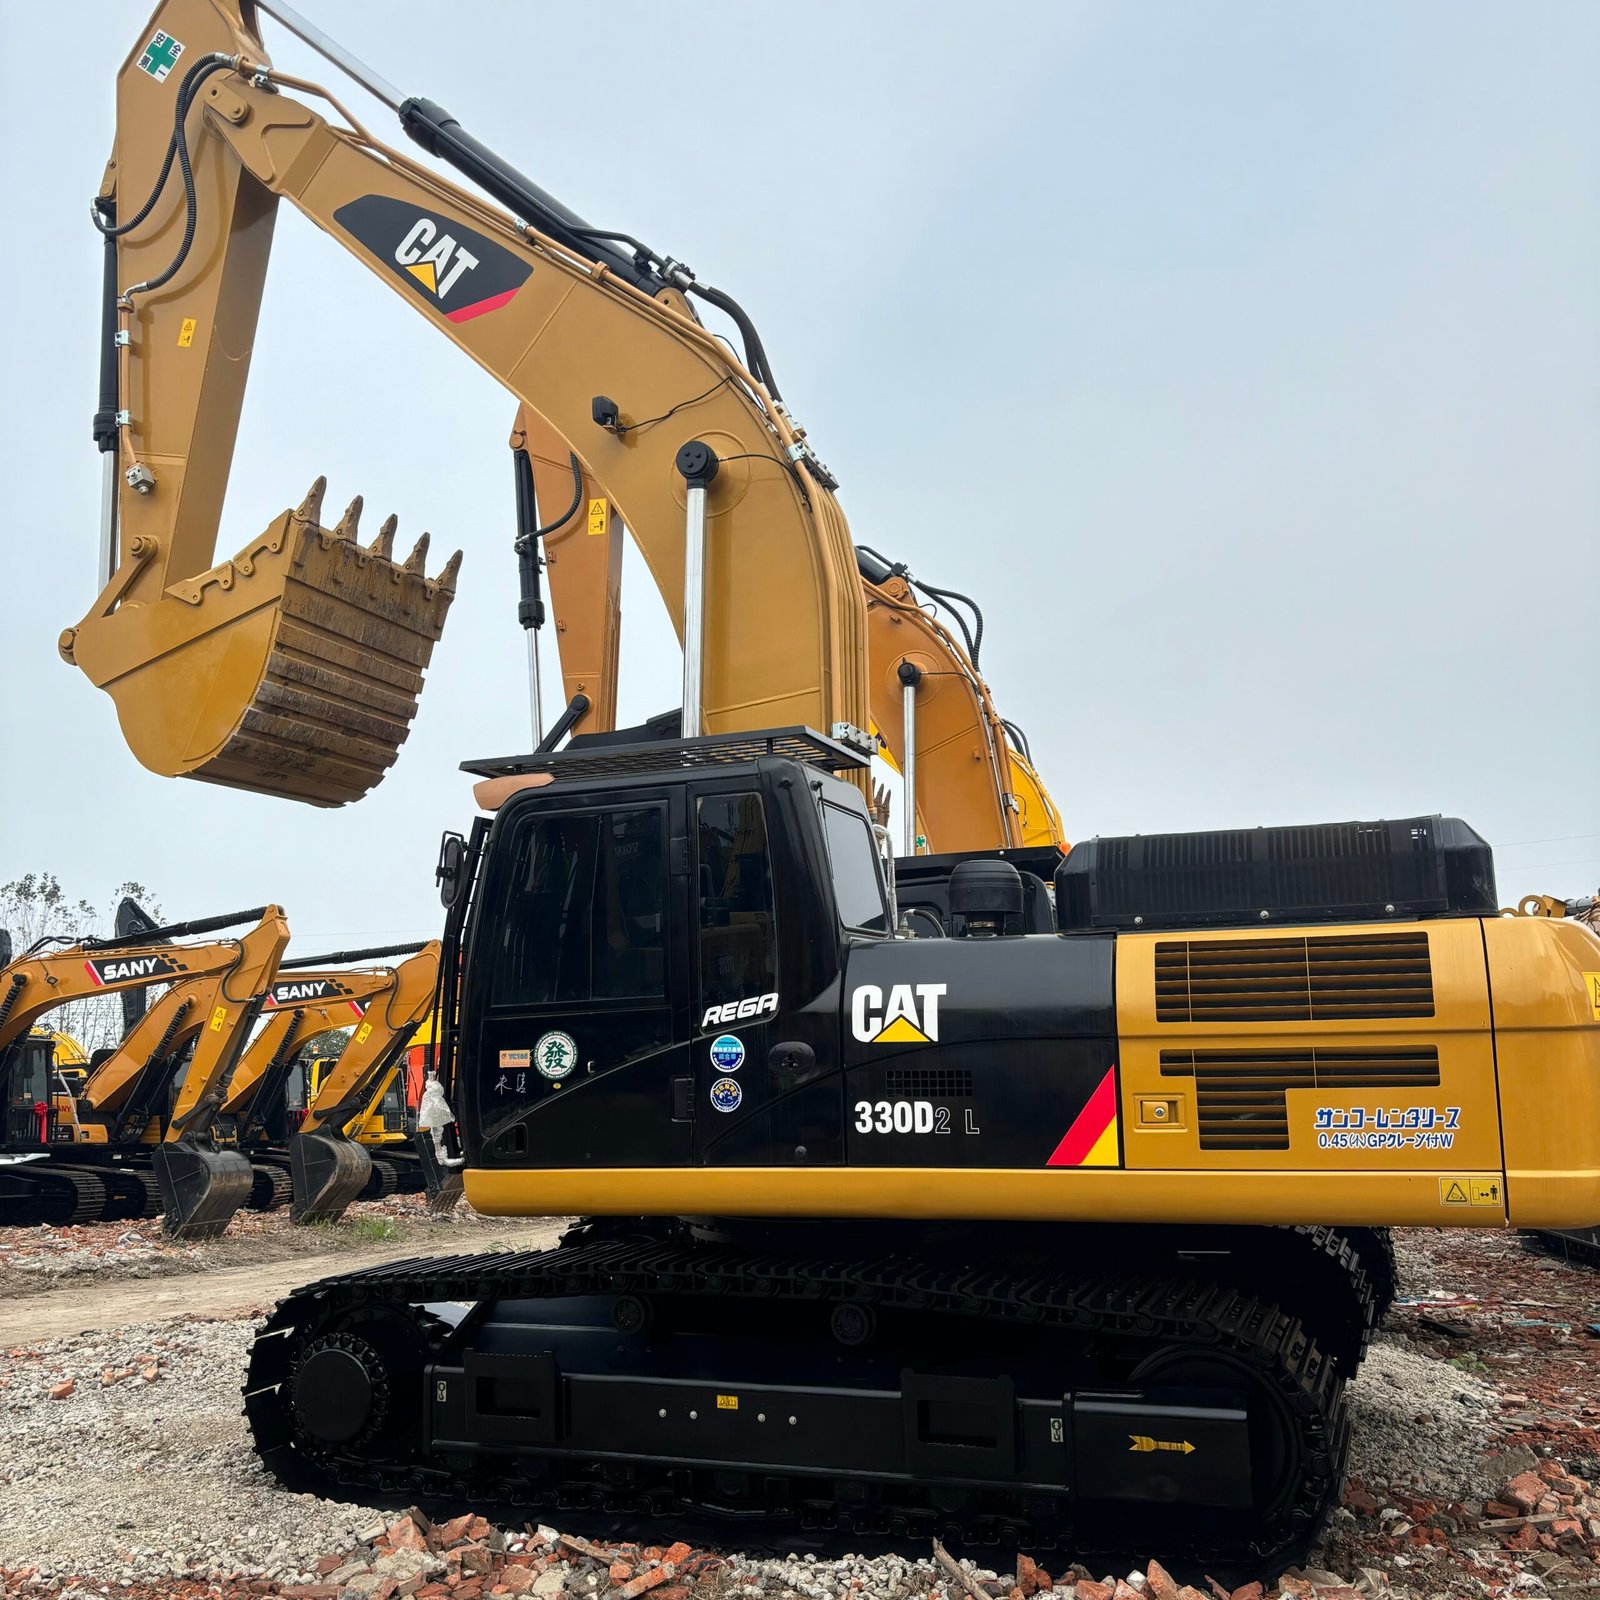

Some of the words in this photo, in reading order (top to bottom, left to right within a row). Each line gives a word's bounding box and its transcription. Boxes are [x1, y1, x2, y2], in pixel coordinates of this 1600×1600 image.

[395, 218, 480, 299] CAT
[103, 957, 158, 980] SANY
[277, 982, 326, 1001] SANY
[702, 993, 779, 1027] REGA
[852, 983, 947, 1043] CAT
[1315, 1107, 1460, 1129] サンコーレンタリース
